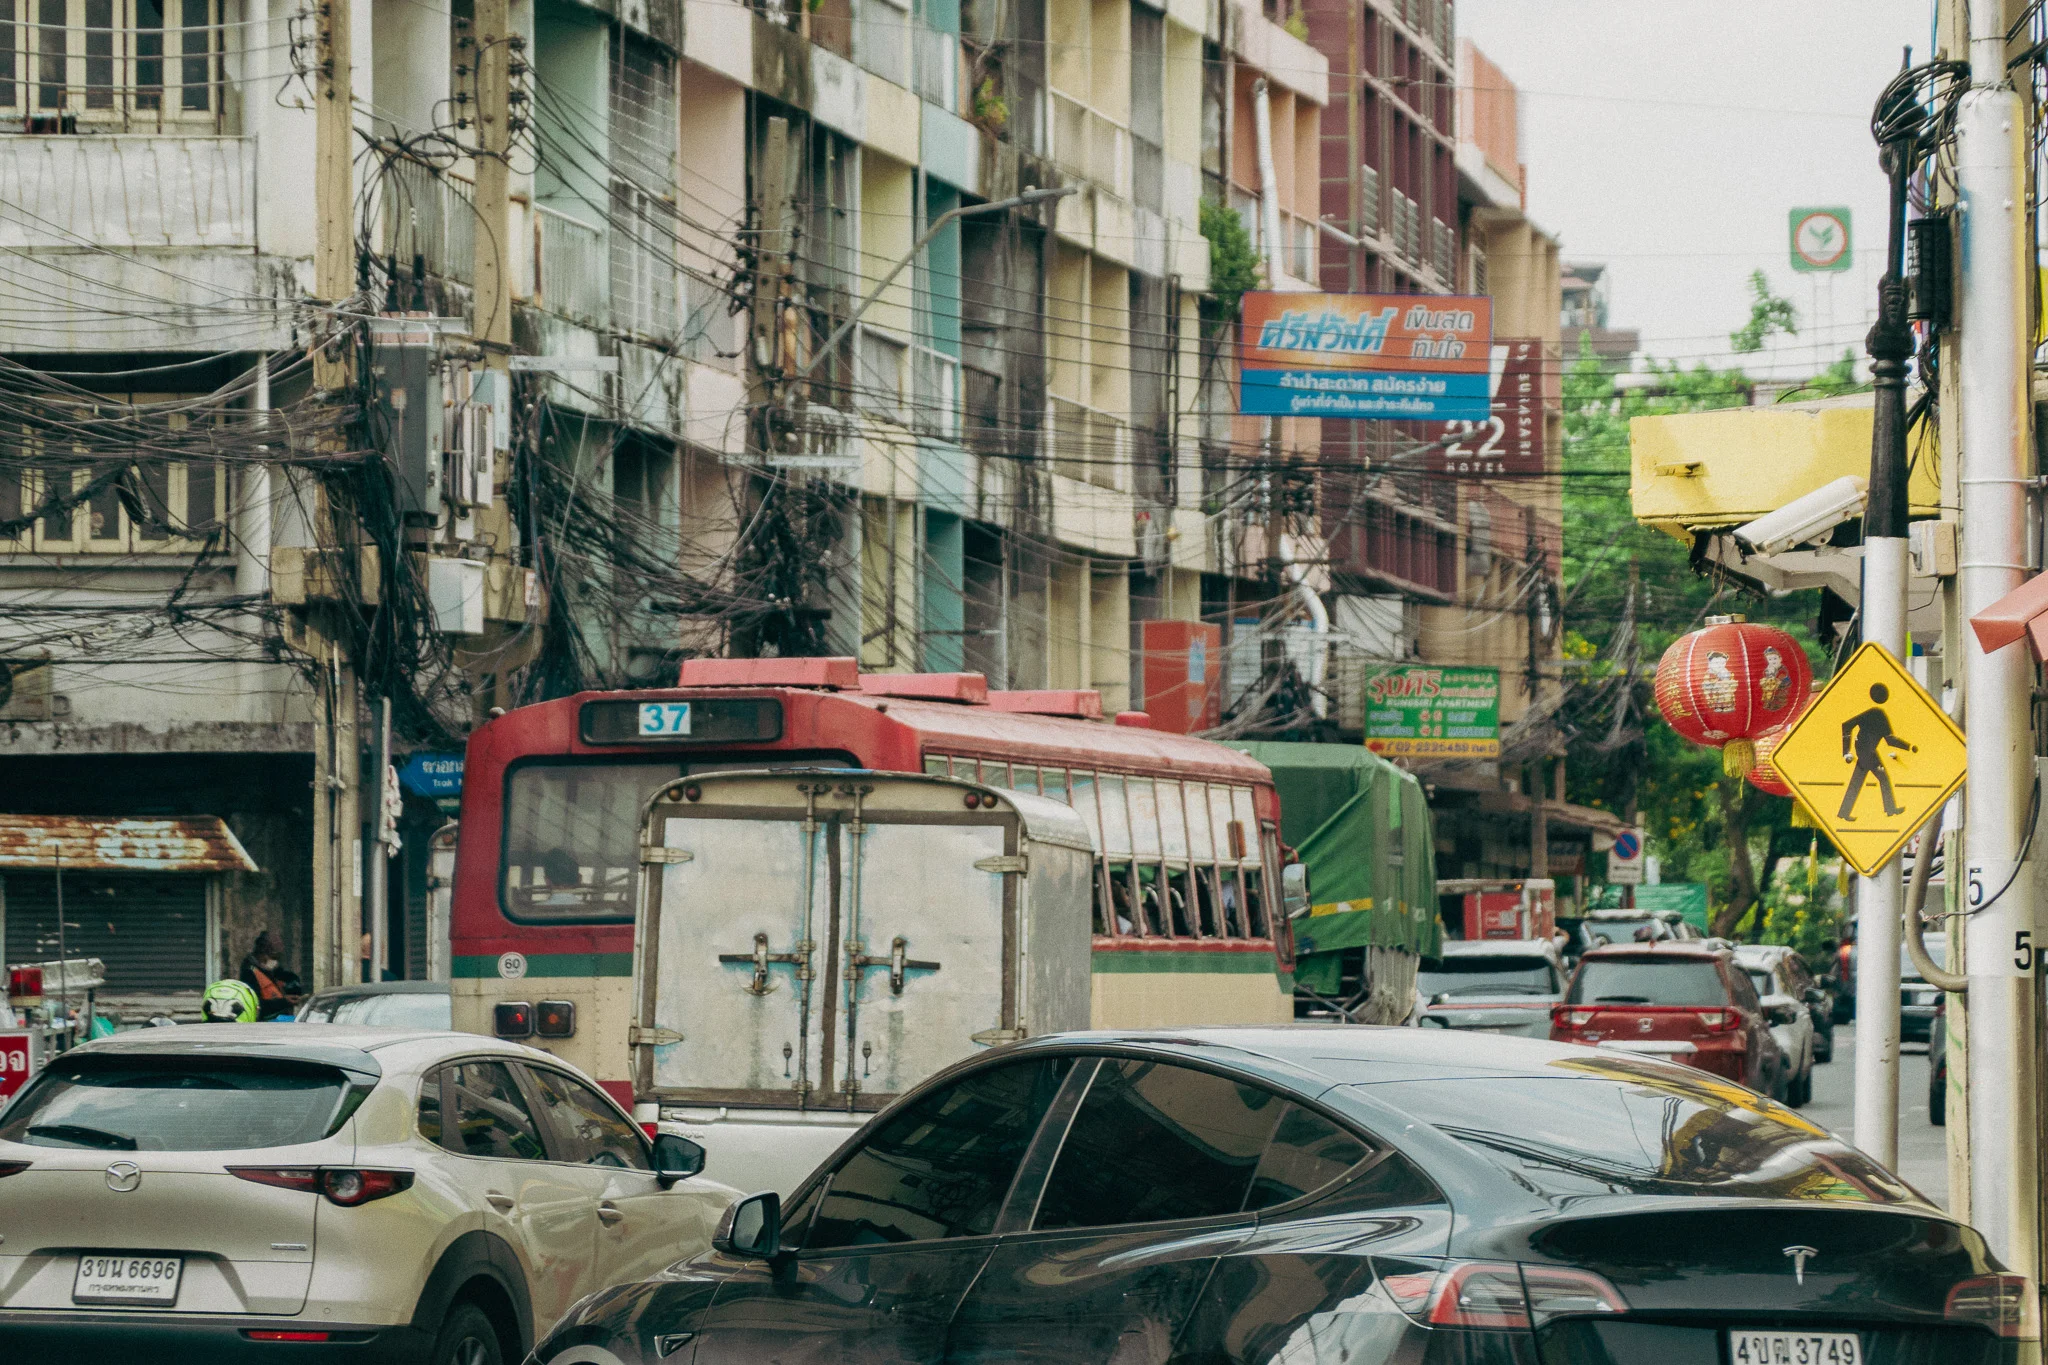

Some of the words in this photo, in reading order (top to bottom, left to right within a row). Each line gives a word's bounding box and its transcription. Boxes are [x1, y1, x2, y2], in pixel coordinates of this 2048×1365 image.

[1257, 306, 1399, 352] ศรีสวัสดิ์
[1404, 304, 1475, 333] เงินสด
[1411, 332, 1467, 361] ทันใจ
[1444, 415, 1507, 458] 22
[1445, 462, 1506, 474] HOTEL
[643, 704, 688, 732] 37
[1968, 867, 1984, 906] 5
[504, 958, 521, 969] 60
[2014, 931, 2032, 970] 5
[128, 1260, 176, 1280] 6696
[1796, 1338, 1854, 1365] 3749
